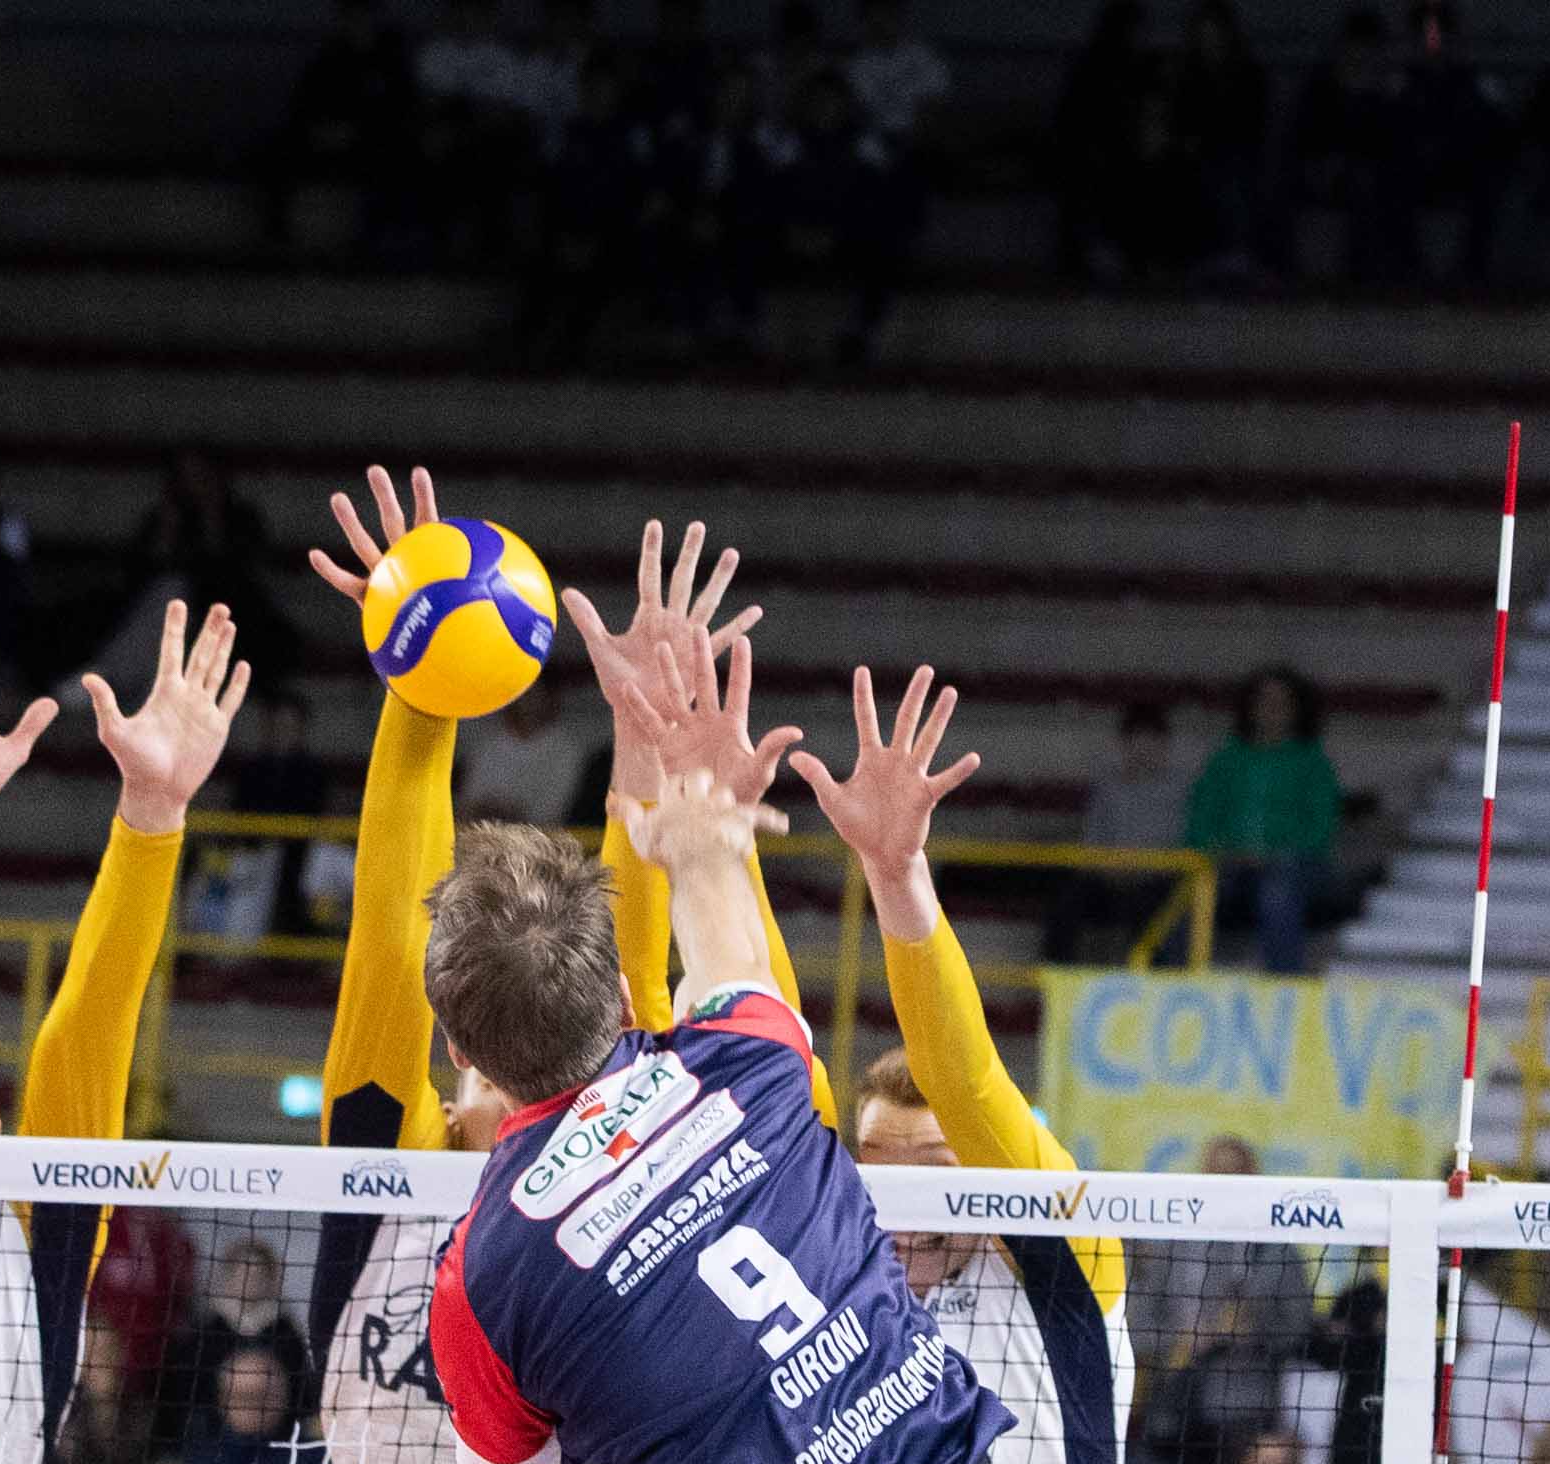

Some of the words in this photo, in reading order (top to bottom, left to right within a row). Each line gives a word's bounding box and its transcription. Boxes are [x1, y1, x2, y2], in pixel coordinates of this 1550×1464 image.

[342, 1172, 413, 1198] RANA
[523, 1067, 676, 1197] GIOIELLA
[605, 1137, 765, 1287] PRISMA
[1270, 1203, 1345, 1232] RANA
[697, 1224, 827, 1362] 9
[769, 1306, 870, 1411] GIRONI
